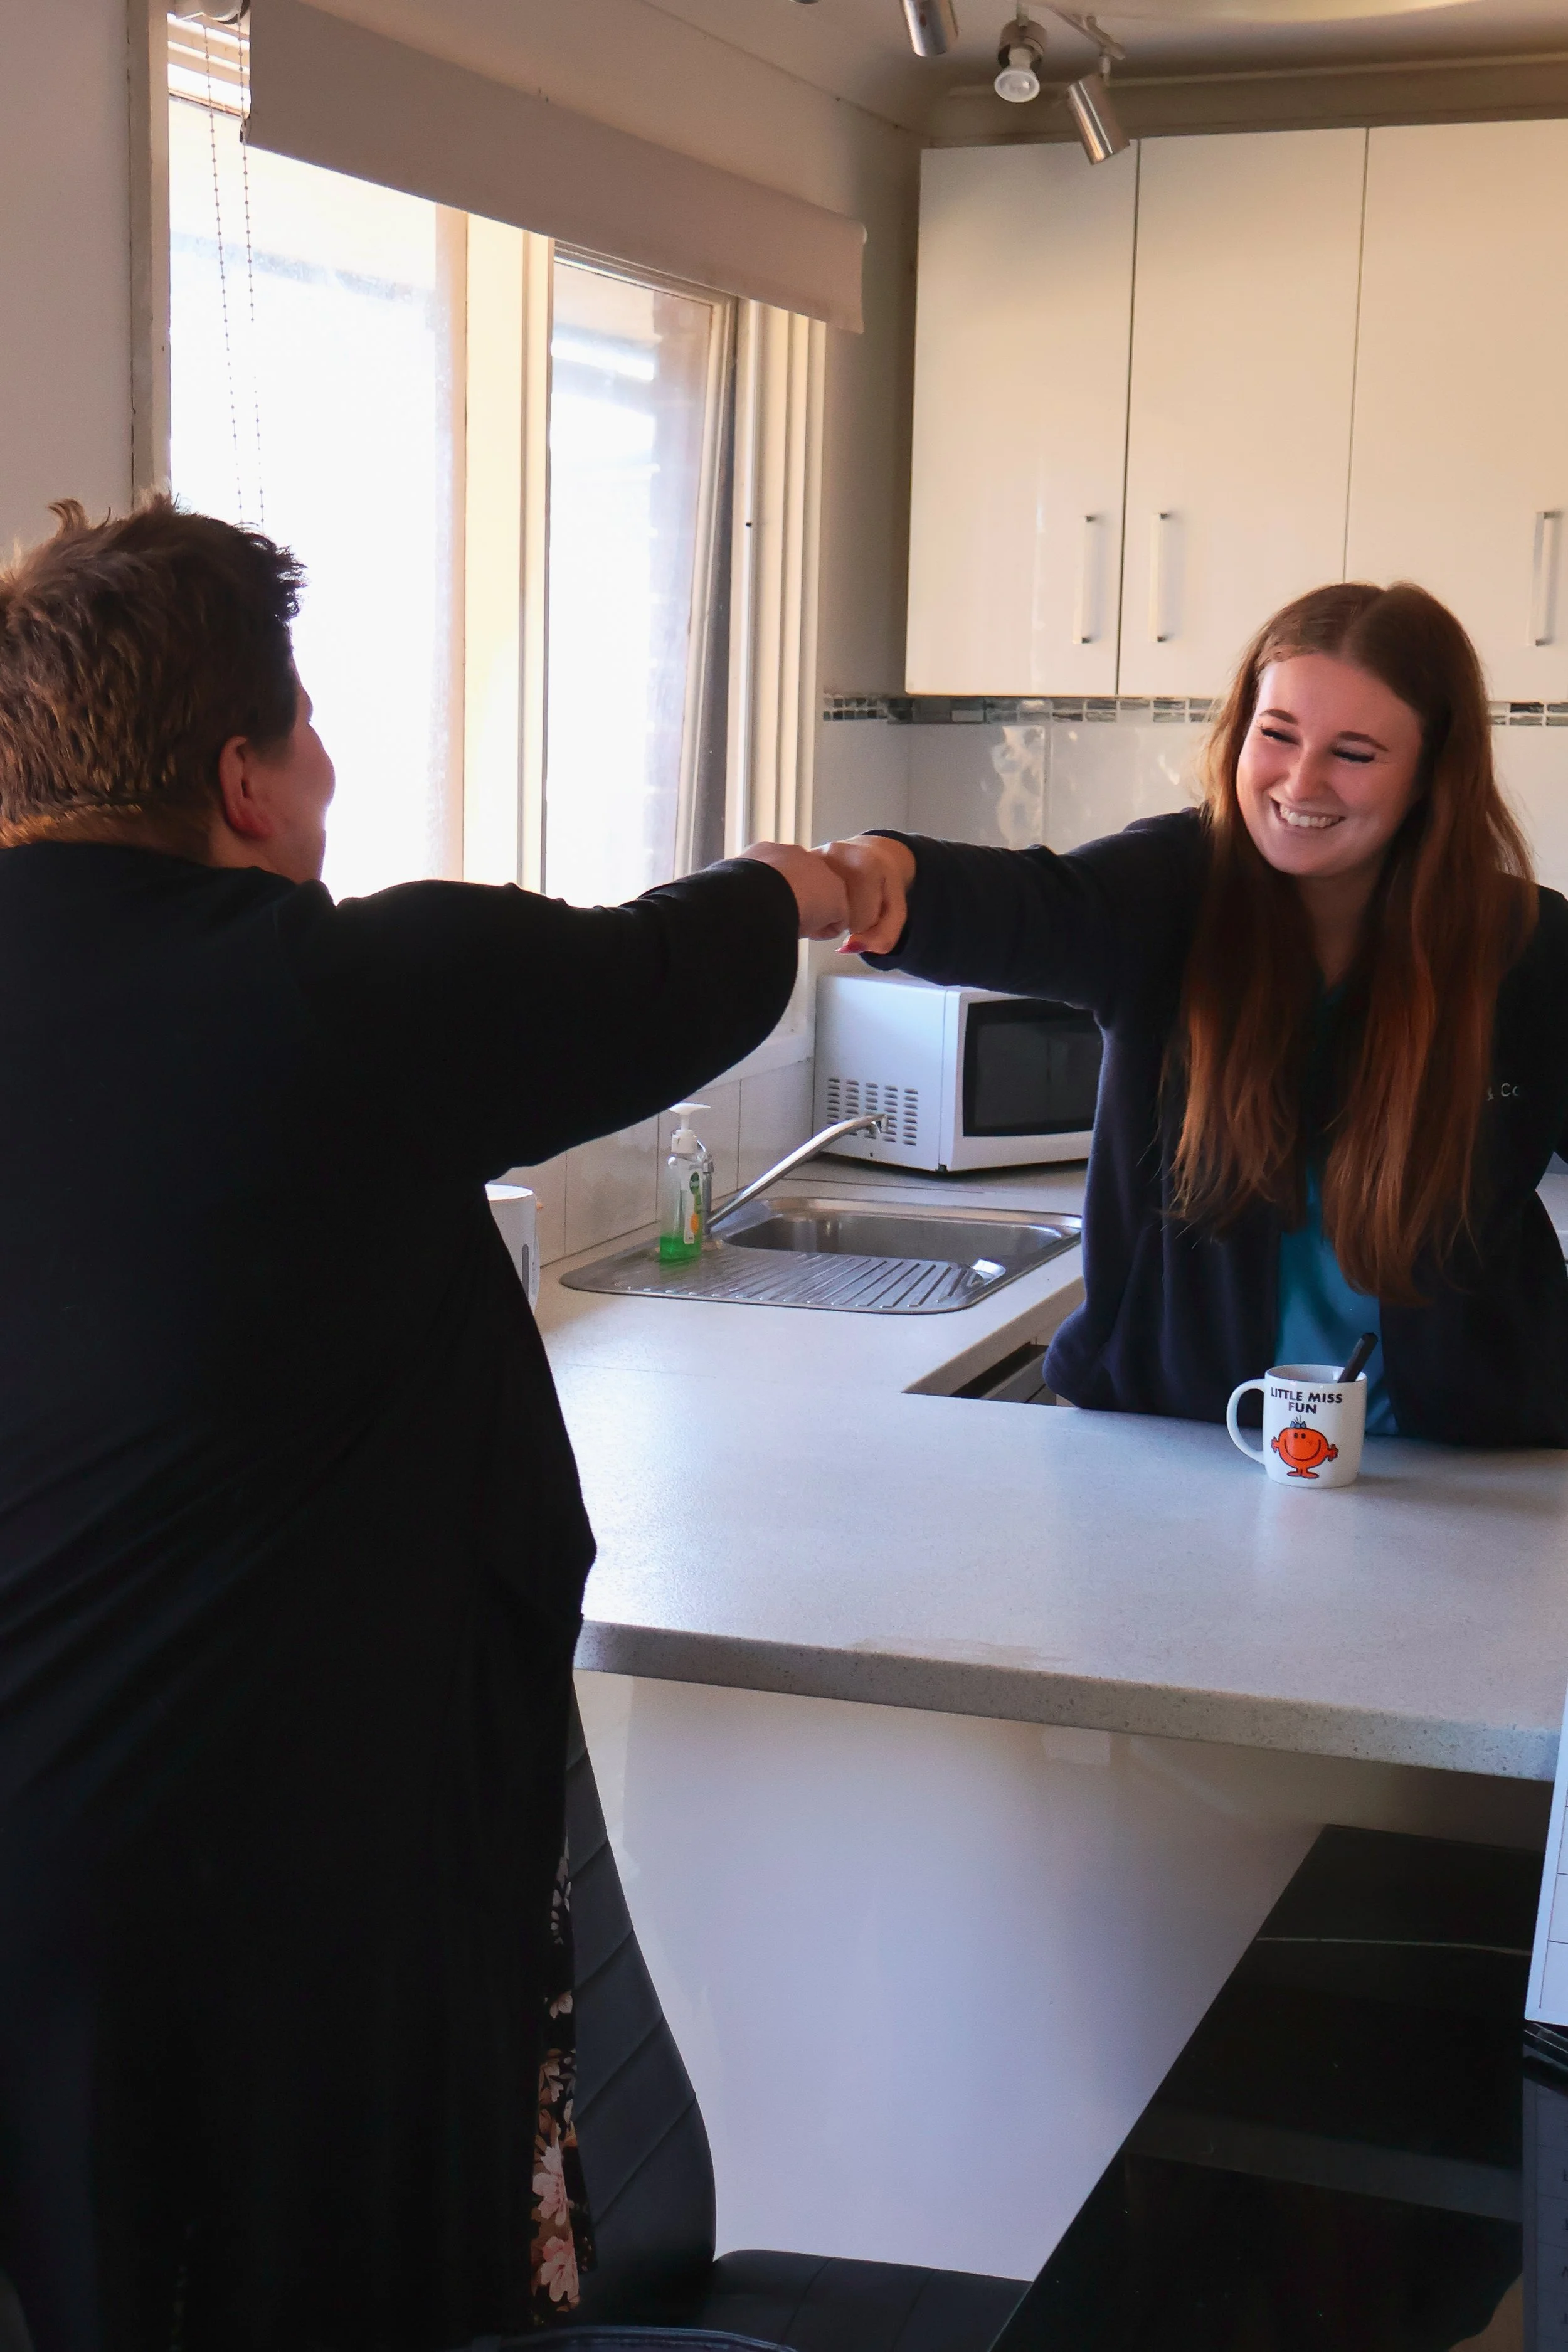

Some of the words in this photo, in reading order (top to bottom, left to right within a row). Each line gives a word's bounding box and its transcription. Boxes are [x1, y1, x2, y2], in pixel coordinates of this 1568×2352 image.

[1271, 1387, 1303, 1401] LITTLE
[1308, 1392, 1343, 1404] MISS
[1288, 1402, 1317, 1414] FUN
